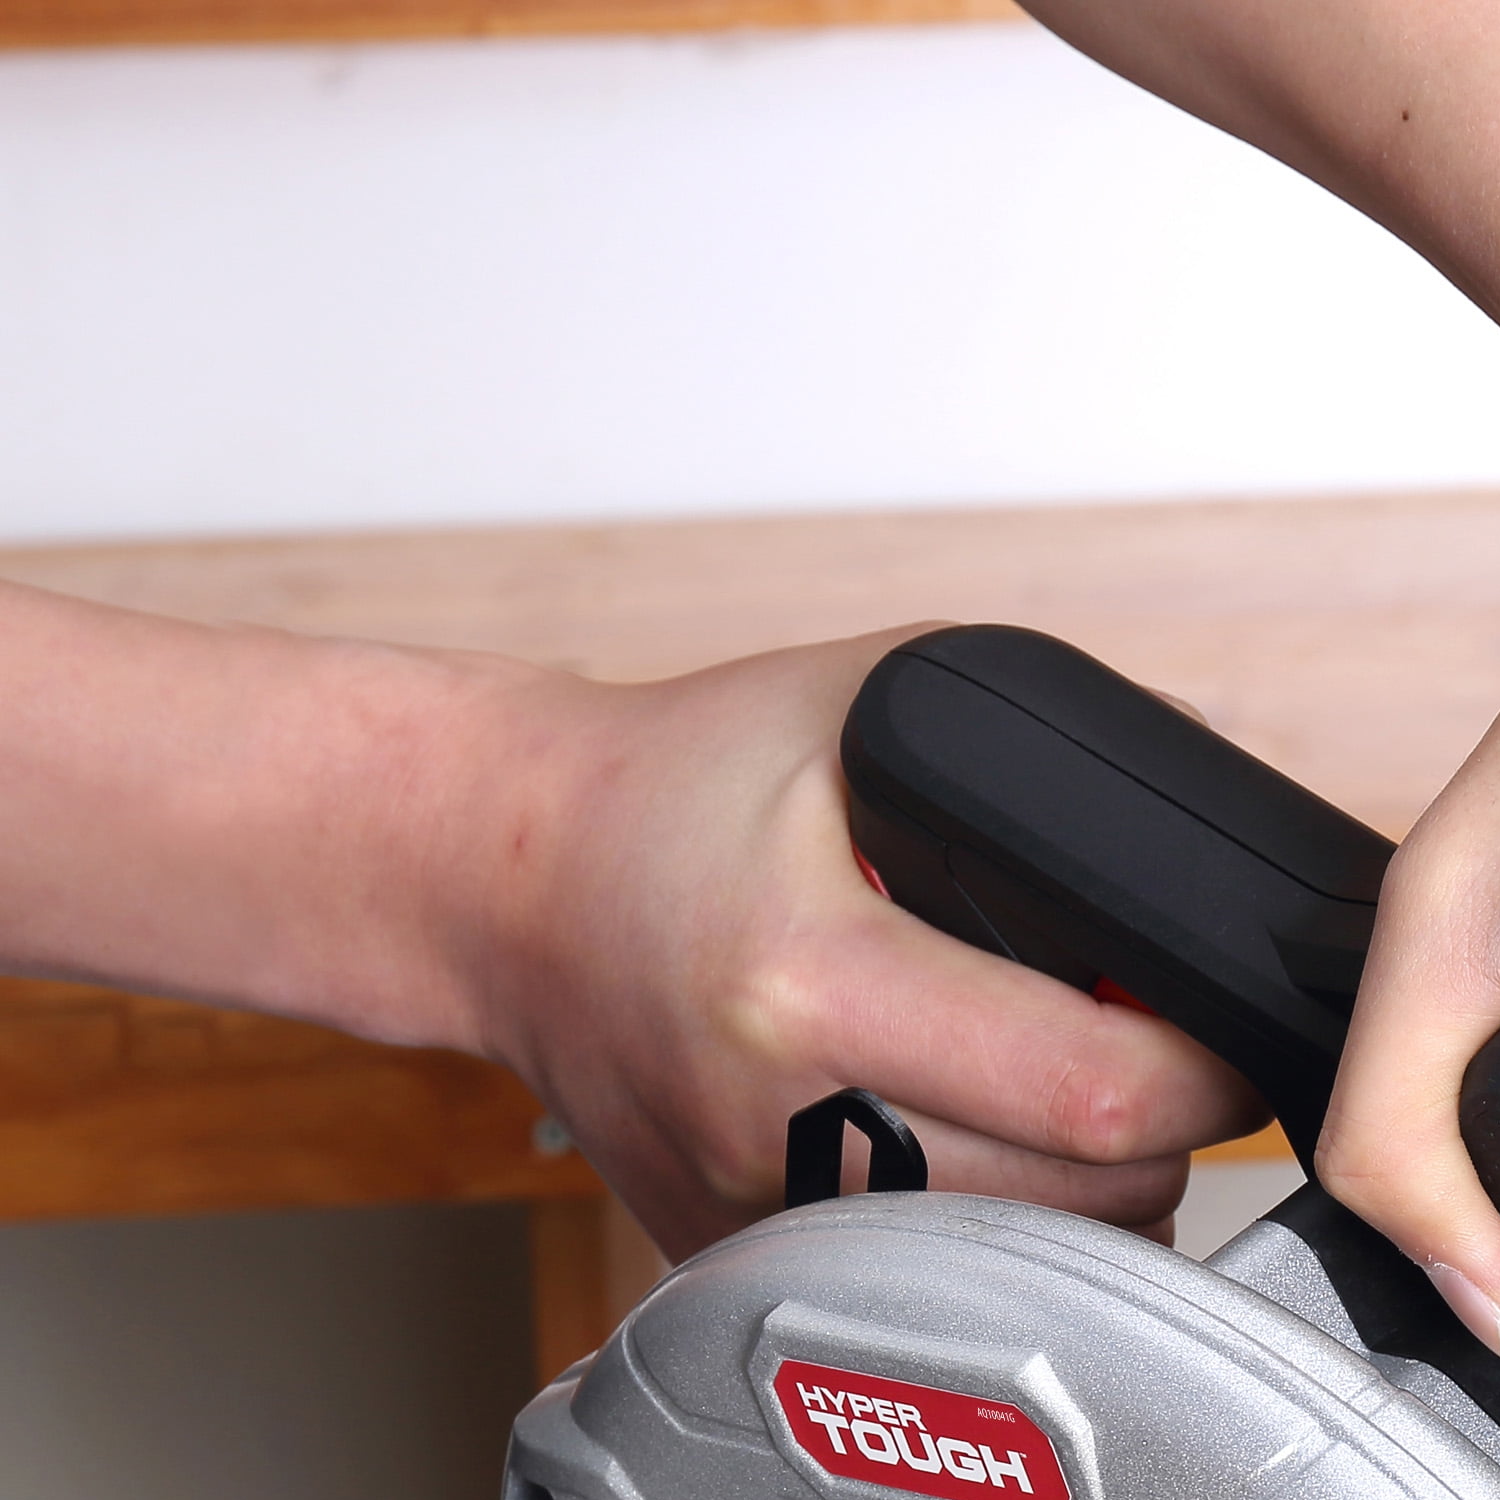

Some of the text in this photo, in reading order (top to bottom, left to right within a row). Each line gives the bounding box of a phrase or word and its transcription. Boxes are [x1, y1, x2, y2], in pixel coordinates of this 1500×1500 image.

[796, 1382, 928, 1430] HYPER
[977, 1407, 1016, 1424] AQ10041G
[806, 1408, 1034, 1494] TOUGH
